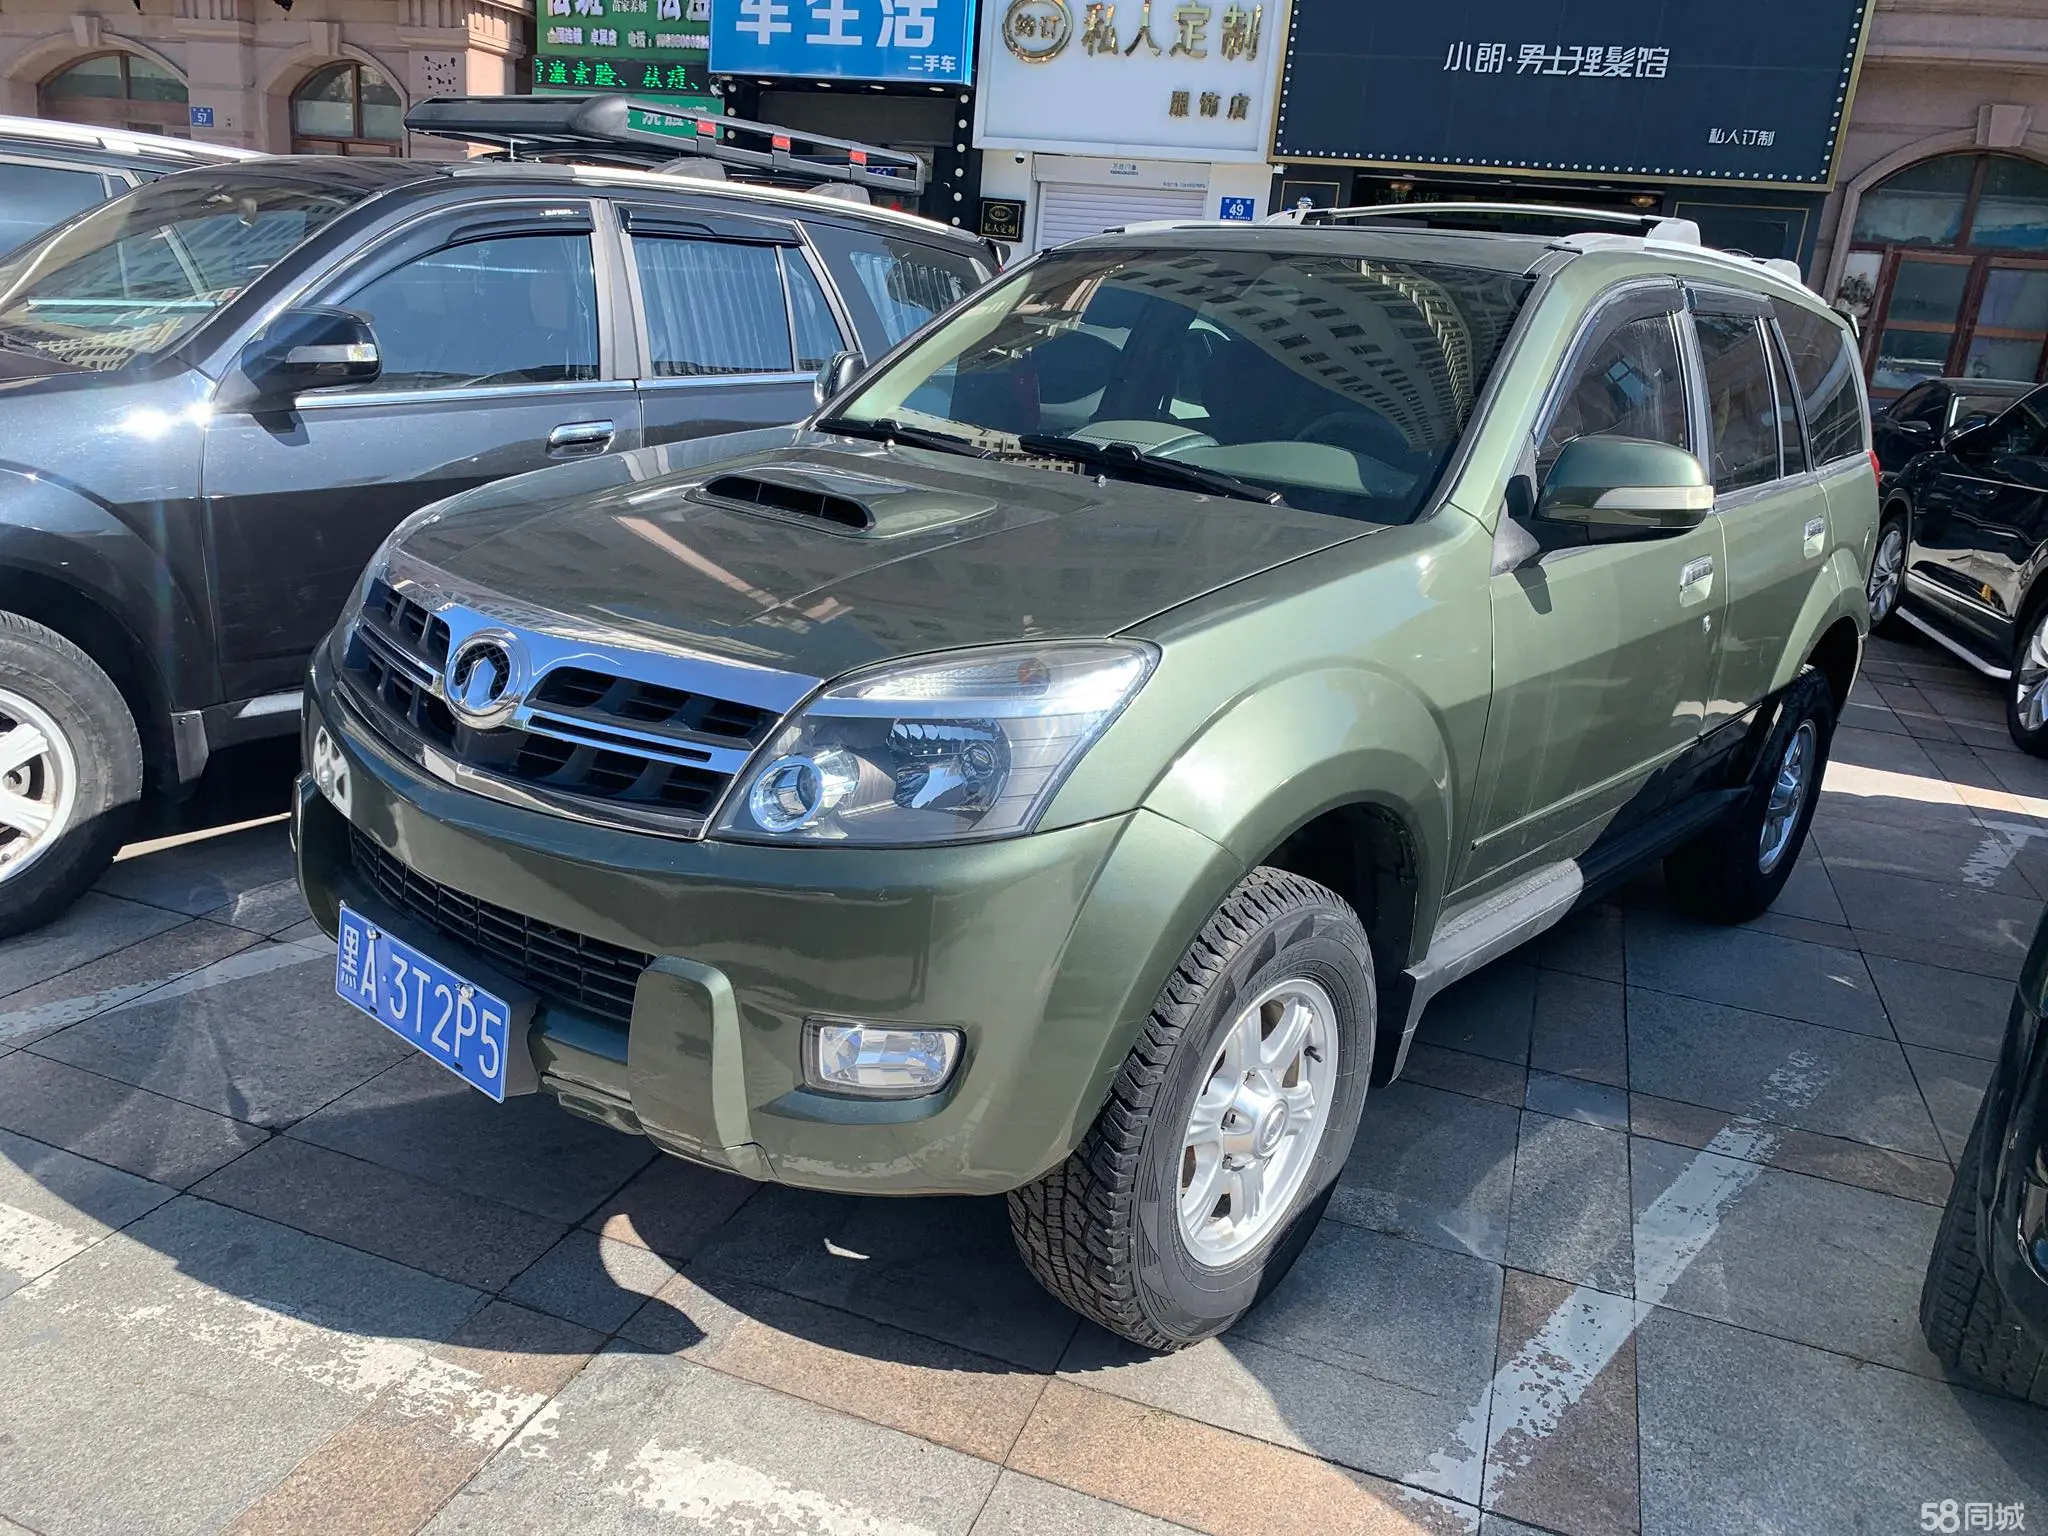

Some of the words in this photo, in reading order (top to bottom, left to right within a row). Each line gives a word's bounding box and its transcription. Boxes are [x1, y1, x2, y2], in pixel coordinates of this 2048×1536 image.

[735, 0, 939, 48] 车生活
[1081, 0, 1263, 61] 私人定制
[908, 54, 956, 73] 二手车
[197, 112, 207, 122] 57
[1708, 127, 1776, 147] 私人订制
[1229, 203, 1244, 216] 49
